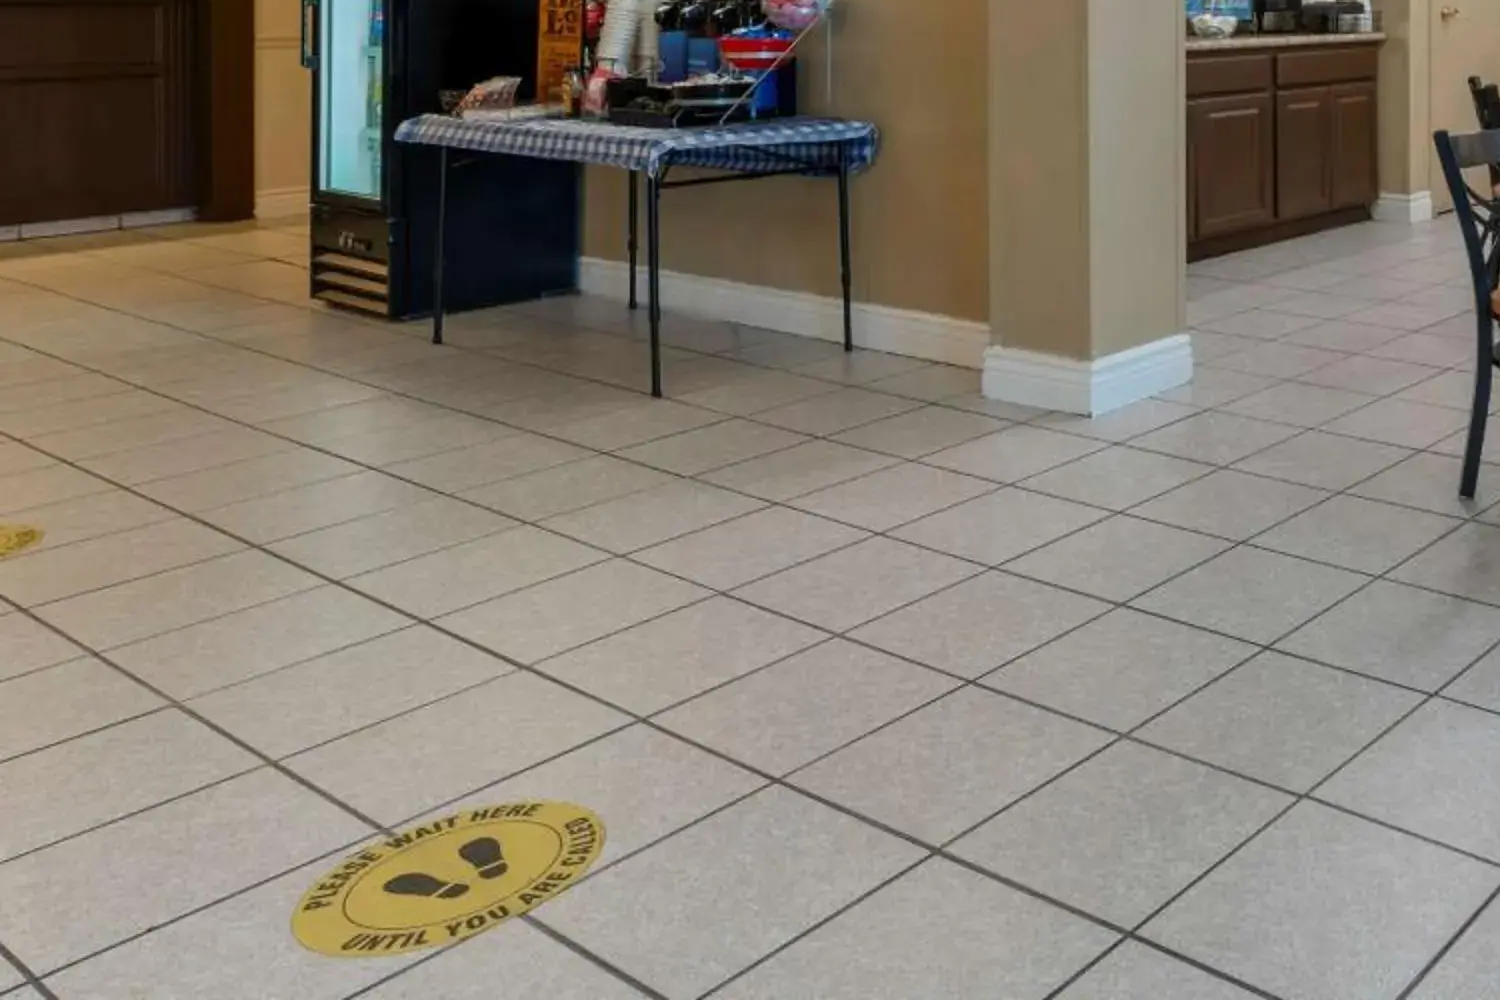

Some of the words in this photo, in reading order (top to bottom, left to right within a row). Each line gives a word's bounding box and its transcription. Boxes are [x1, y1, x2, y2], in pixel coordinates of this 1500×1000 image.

[303, 850, 381, 912] PLEASE
[384, 815, 460, 849] WAIT
[470, 803, 544, 822] HERE
[341, 930, 429, 952] UNTIL
[444, 905, 510, 938] YOU
[518, 870, 572, 906] ARE
[560, 817, 597, 867] CALLED
